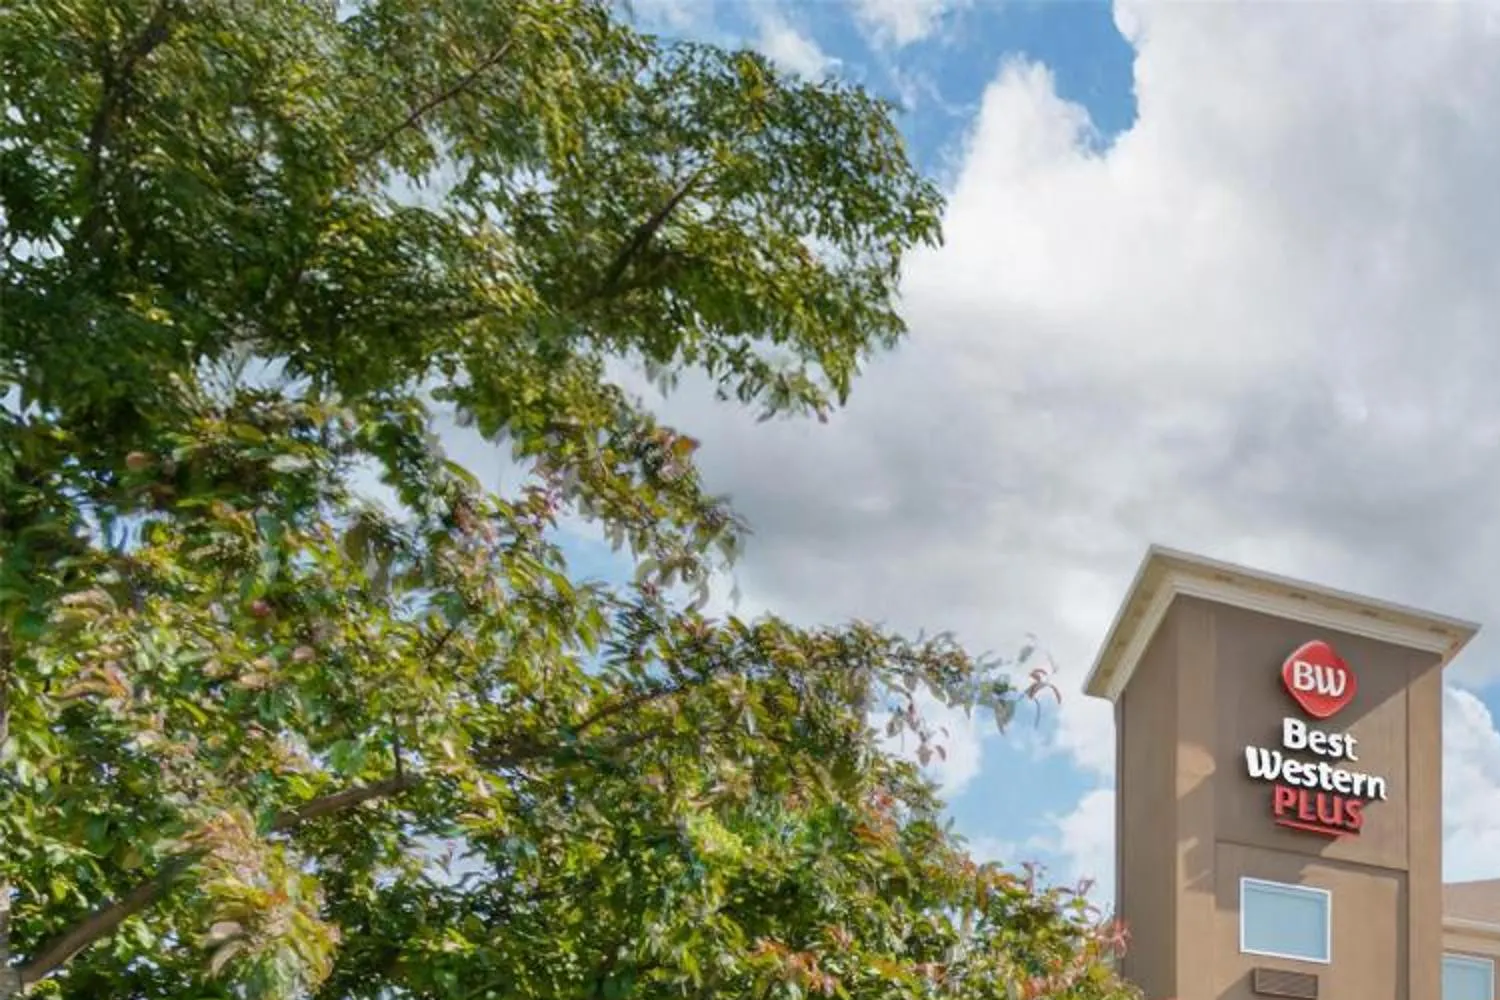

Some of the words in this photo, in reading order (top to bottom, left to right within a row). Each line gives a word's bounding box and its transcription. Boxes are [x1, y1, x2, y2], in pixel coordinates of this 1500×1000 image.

[1293, 661, 1347, 697] BW
[1283, 717, 1359, 761] Best
[1245, 746, 1388, 800] Western
[1273, 785, 1365, 829] PLUS
